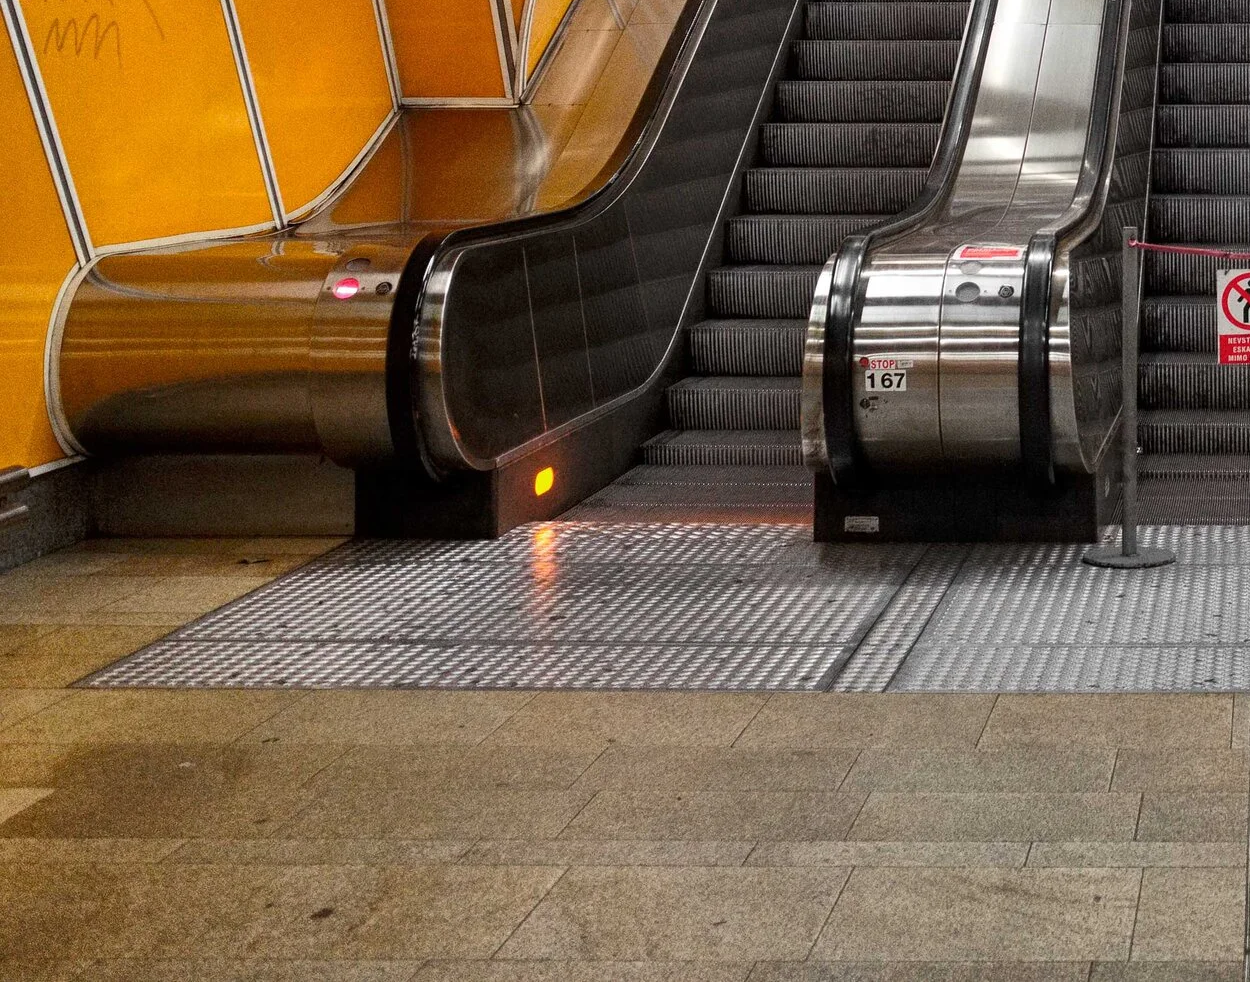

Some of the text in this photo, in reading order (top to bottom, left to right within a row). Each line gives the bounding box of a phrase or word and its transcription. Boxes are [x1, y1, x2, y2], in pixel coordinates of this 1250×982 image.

[1228, 354, 1248, 362] MIMO
[870, 359, 895, 369] STOP
[867, 372, 905, 388] 167
